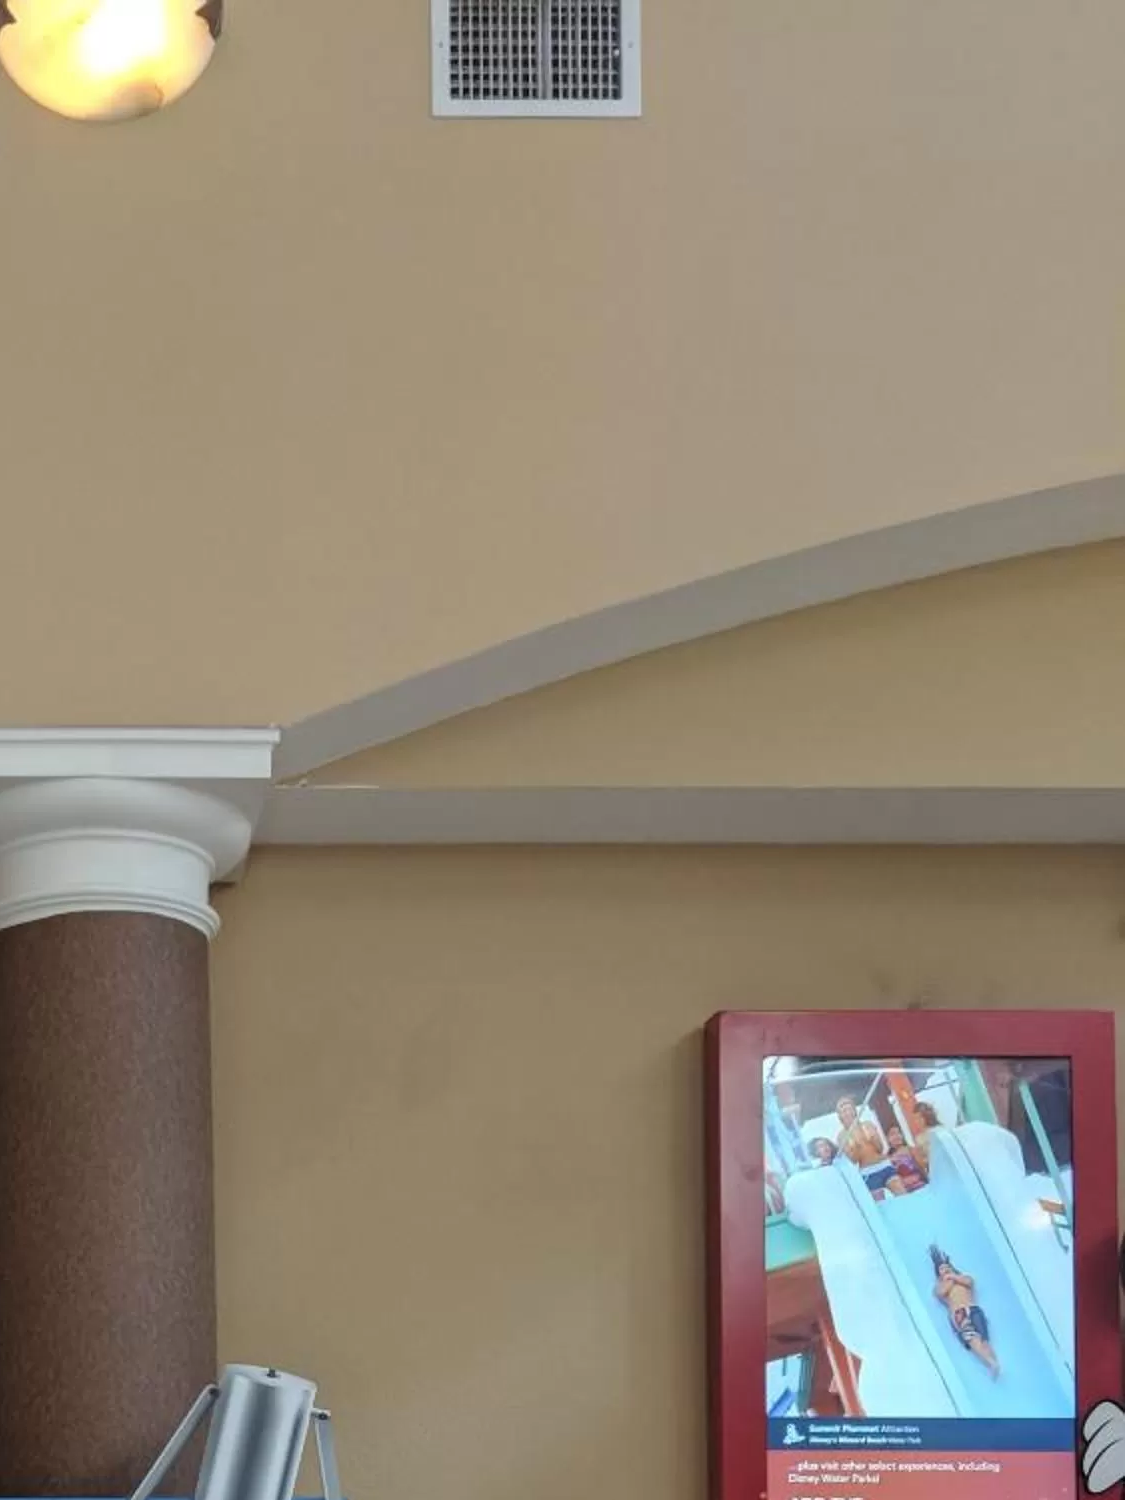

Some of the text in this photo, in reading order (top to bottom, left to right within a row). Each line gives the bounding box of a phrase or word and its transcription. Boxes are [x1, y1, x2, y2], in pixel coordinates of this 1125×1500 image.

[821, 1461, 840, 1471] visit
[841, 1461, 866, 1471] other
[868, 1461, 897, 1471] select
[958, 1462, 1001, 1474] including
[788, 1474, 819, 1485] Disney
